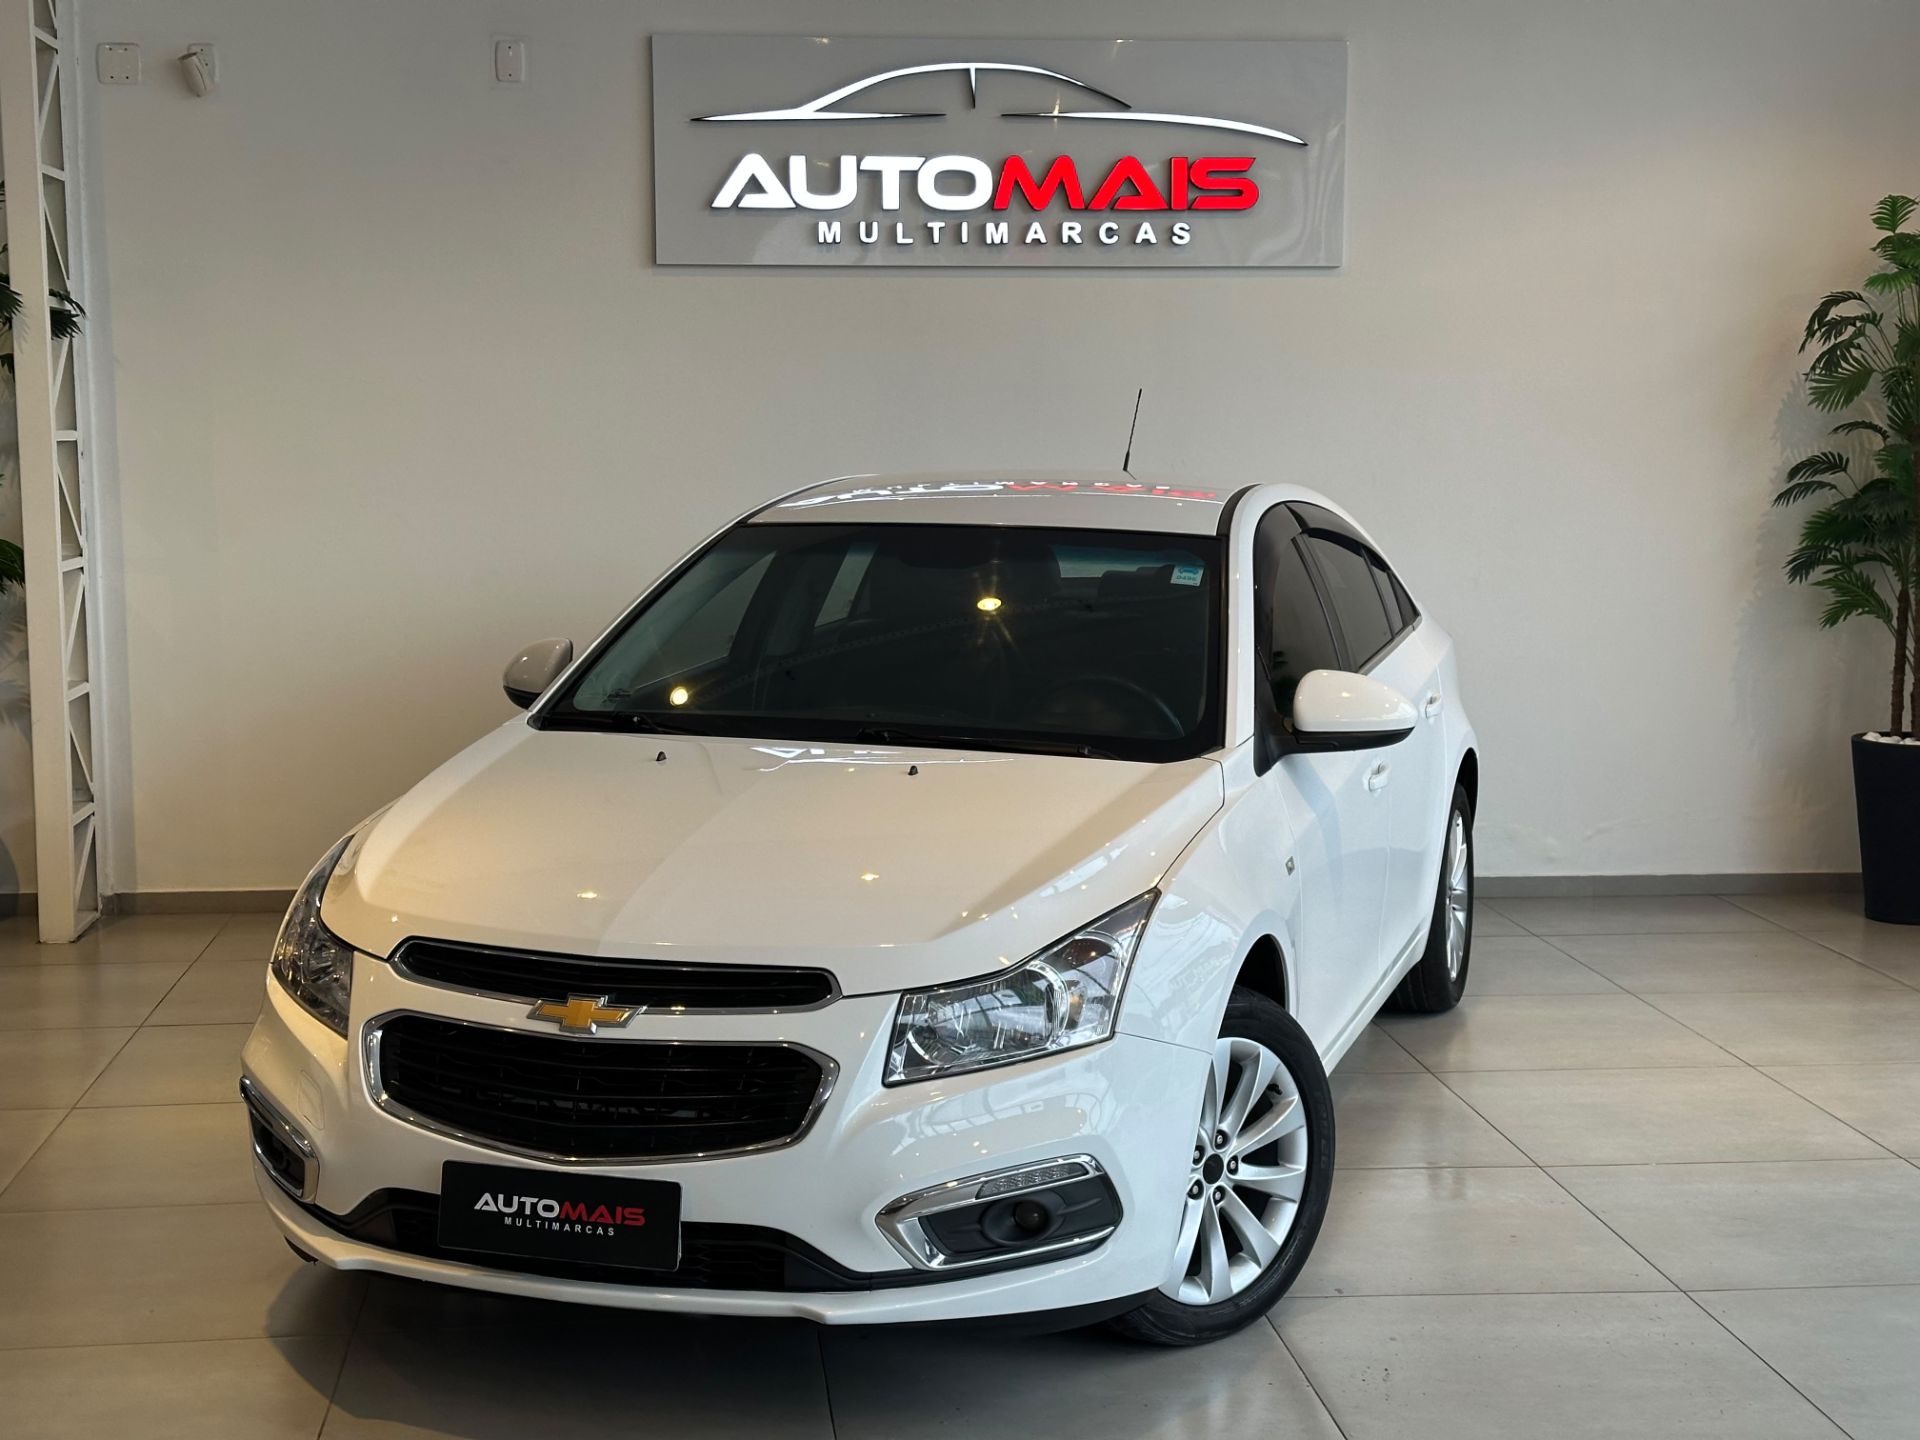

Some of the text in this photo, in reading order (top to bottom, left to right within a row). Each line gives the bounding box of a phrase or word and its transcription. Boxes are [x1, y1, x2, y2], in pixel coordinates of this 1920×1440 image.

[710, 152, 1259, 212] AUTOMAIS
[817, 221, 1193, 245] MULTIMARCAS
[474, 1192, 646, 1226] AUTOMAIS
[504, 1216, 615, 1236] MULTIMARCAS
